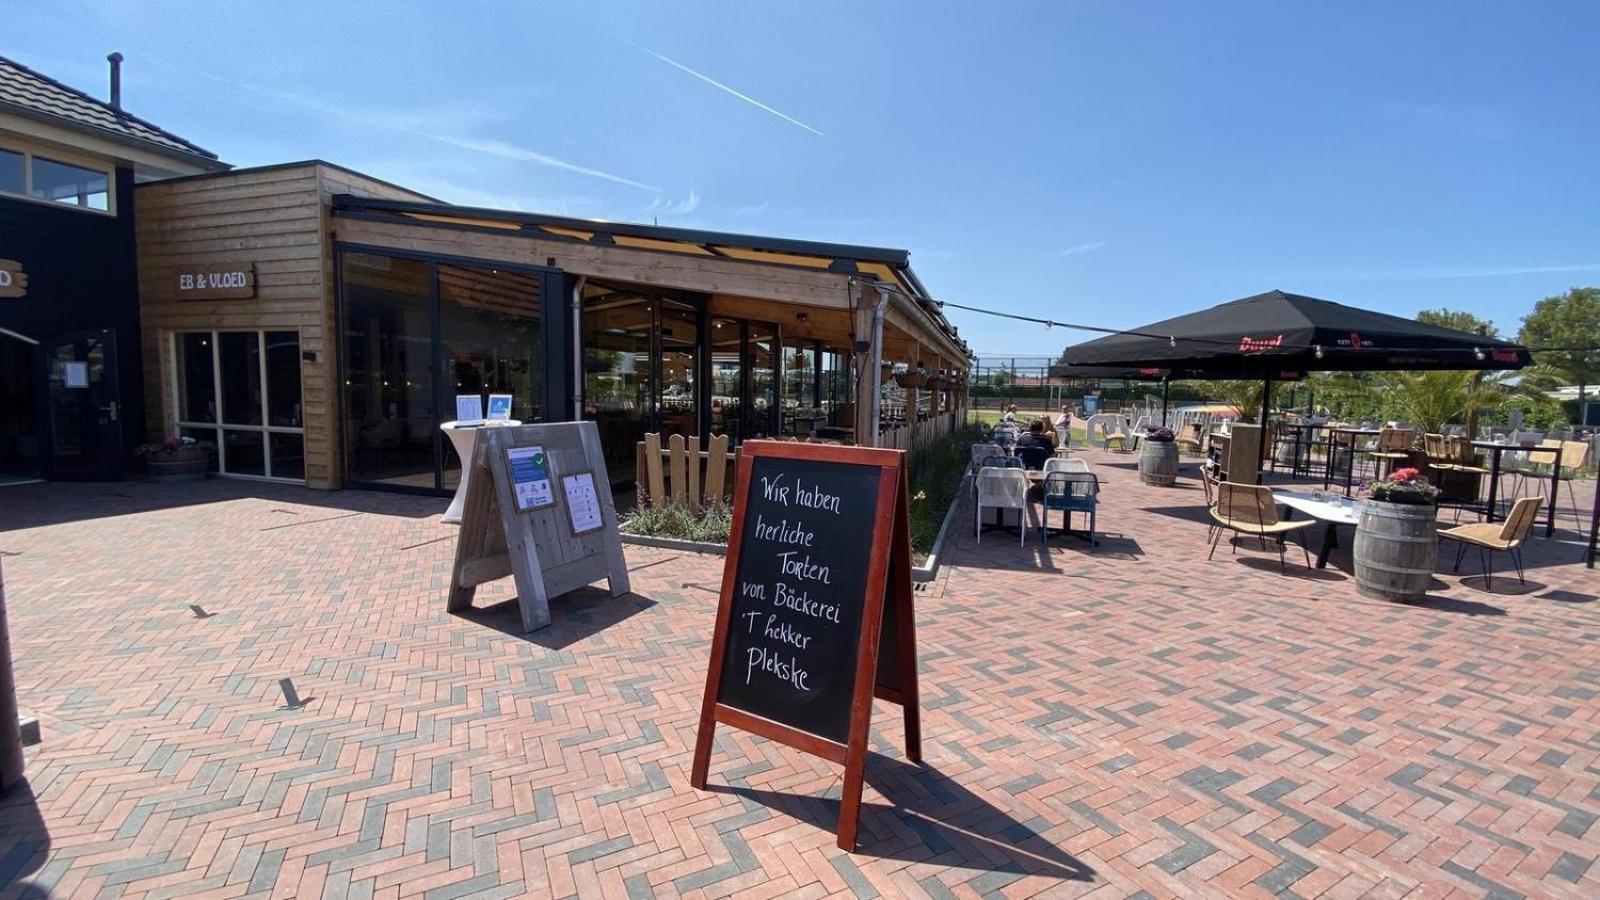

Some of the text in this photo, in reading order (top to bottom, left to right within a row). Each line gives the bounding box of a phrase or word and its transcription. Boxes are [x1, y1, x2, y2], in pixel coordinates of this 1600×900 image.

[180, 271, 247, 290] EB & VLOED
[795, 477, 841, 515] haben
[754, 513, 814, 547] herliche
[742, 581, 841, 624] von Bäckerei
[746, 646, 812, 691] Plekske
